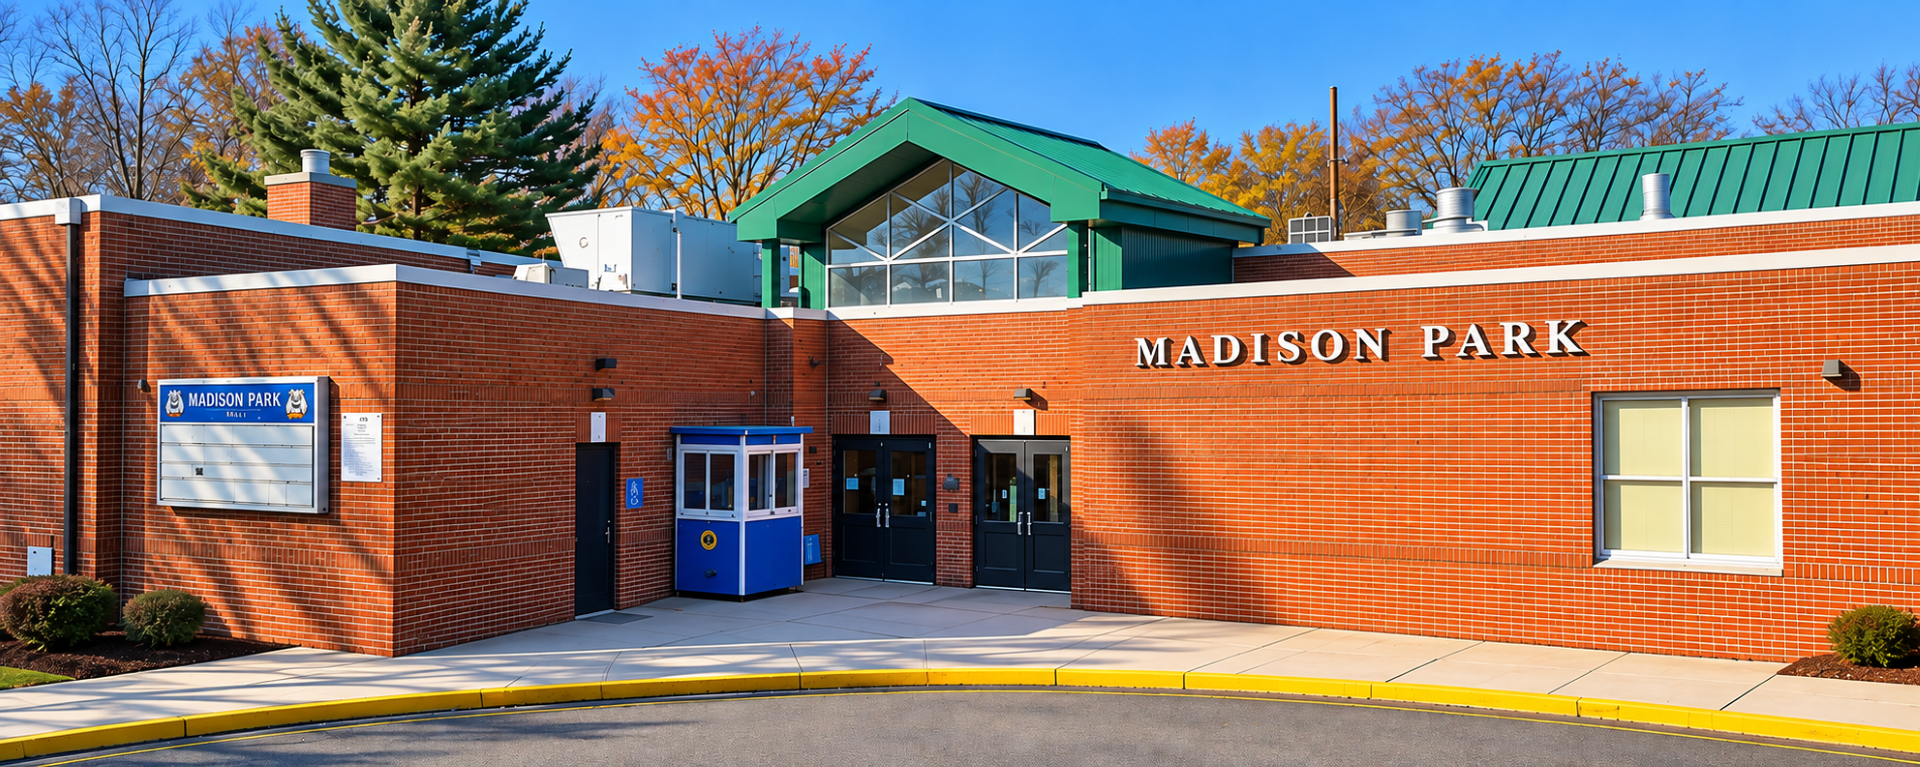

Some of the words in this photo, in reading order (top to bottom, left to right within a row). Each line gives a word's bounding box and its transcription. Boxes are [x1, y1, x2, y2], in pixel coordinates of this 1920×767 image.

[1134, 328, 1388, 367] MADISON
[1420, 319, 1584, 358] PARK
[188, 392, 244, 407] MADISON
[248, 392, 281, 407] PARK
